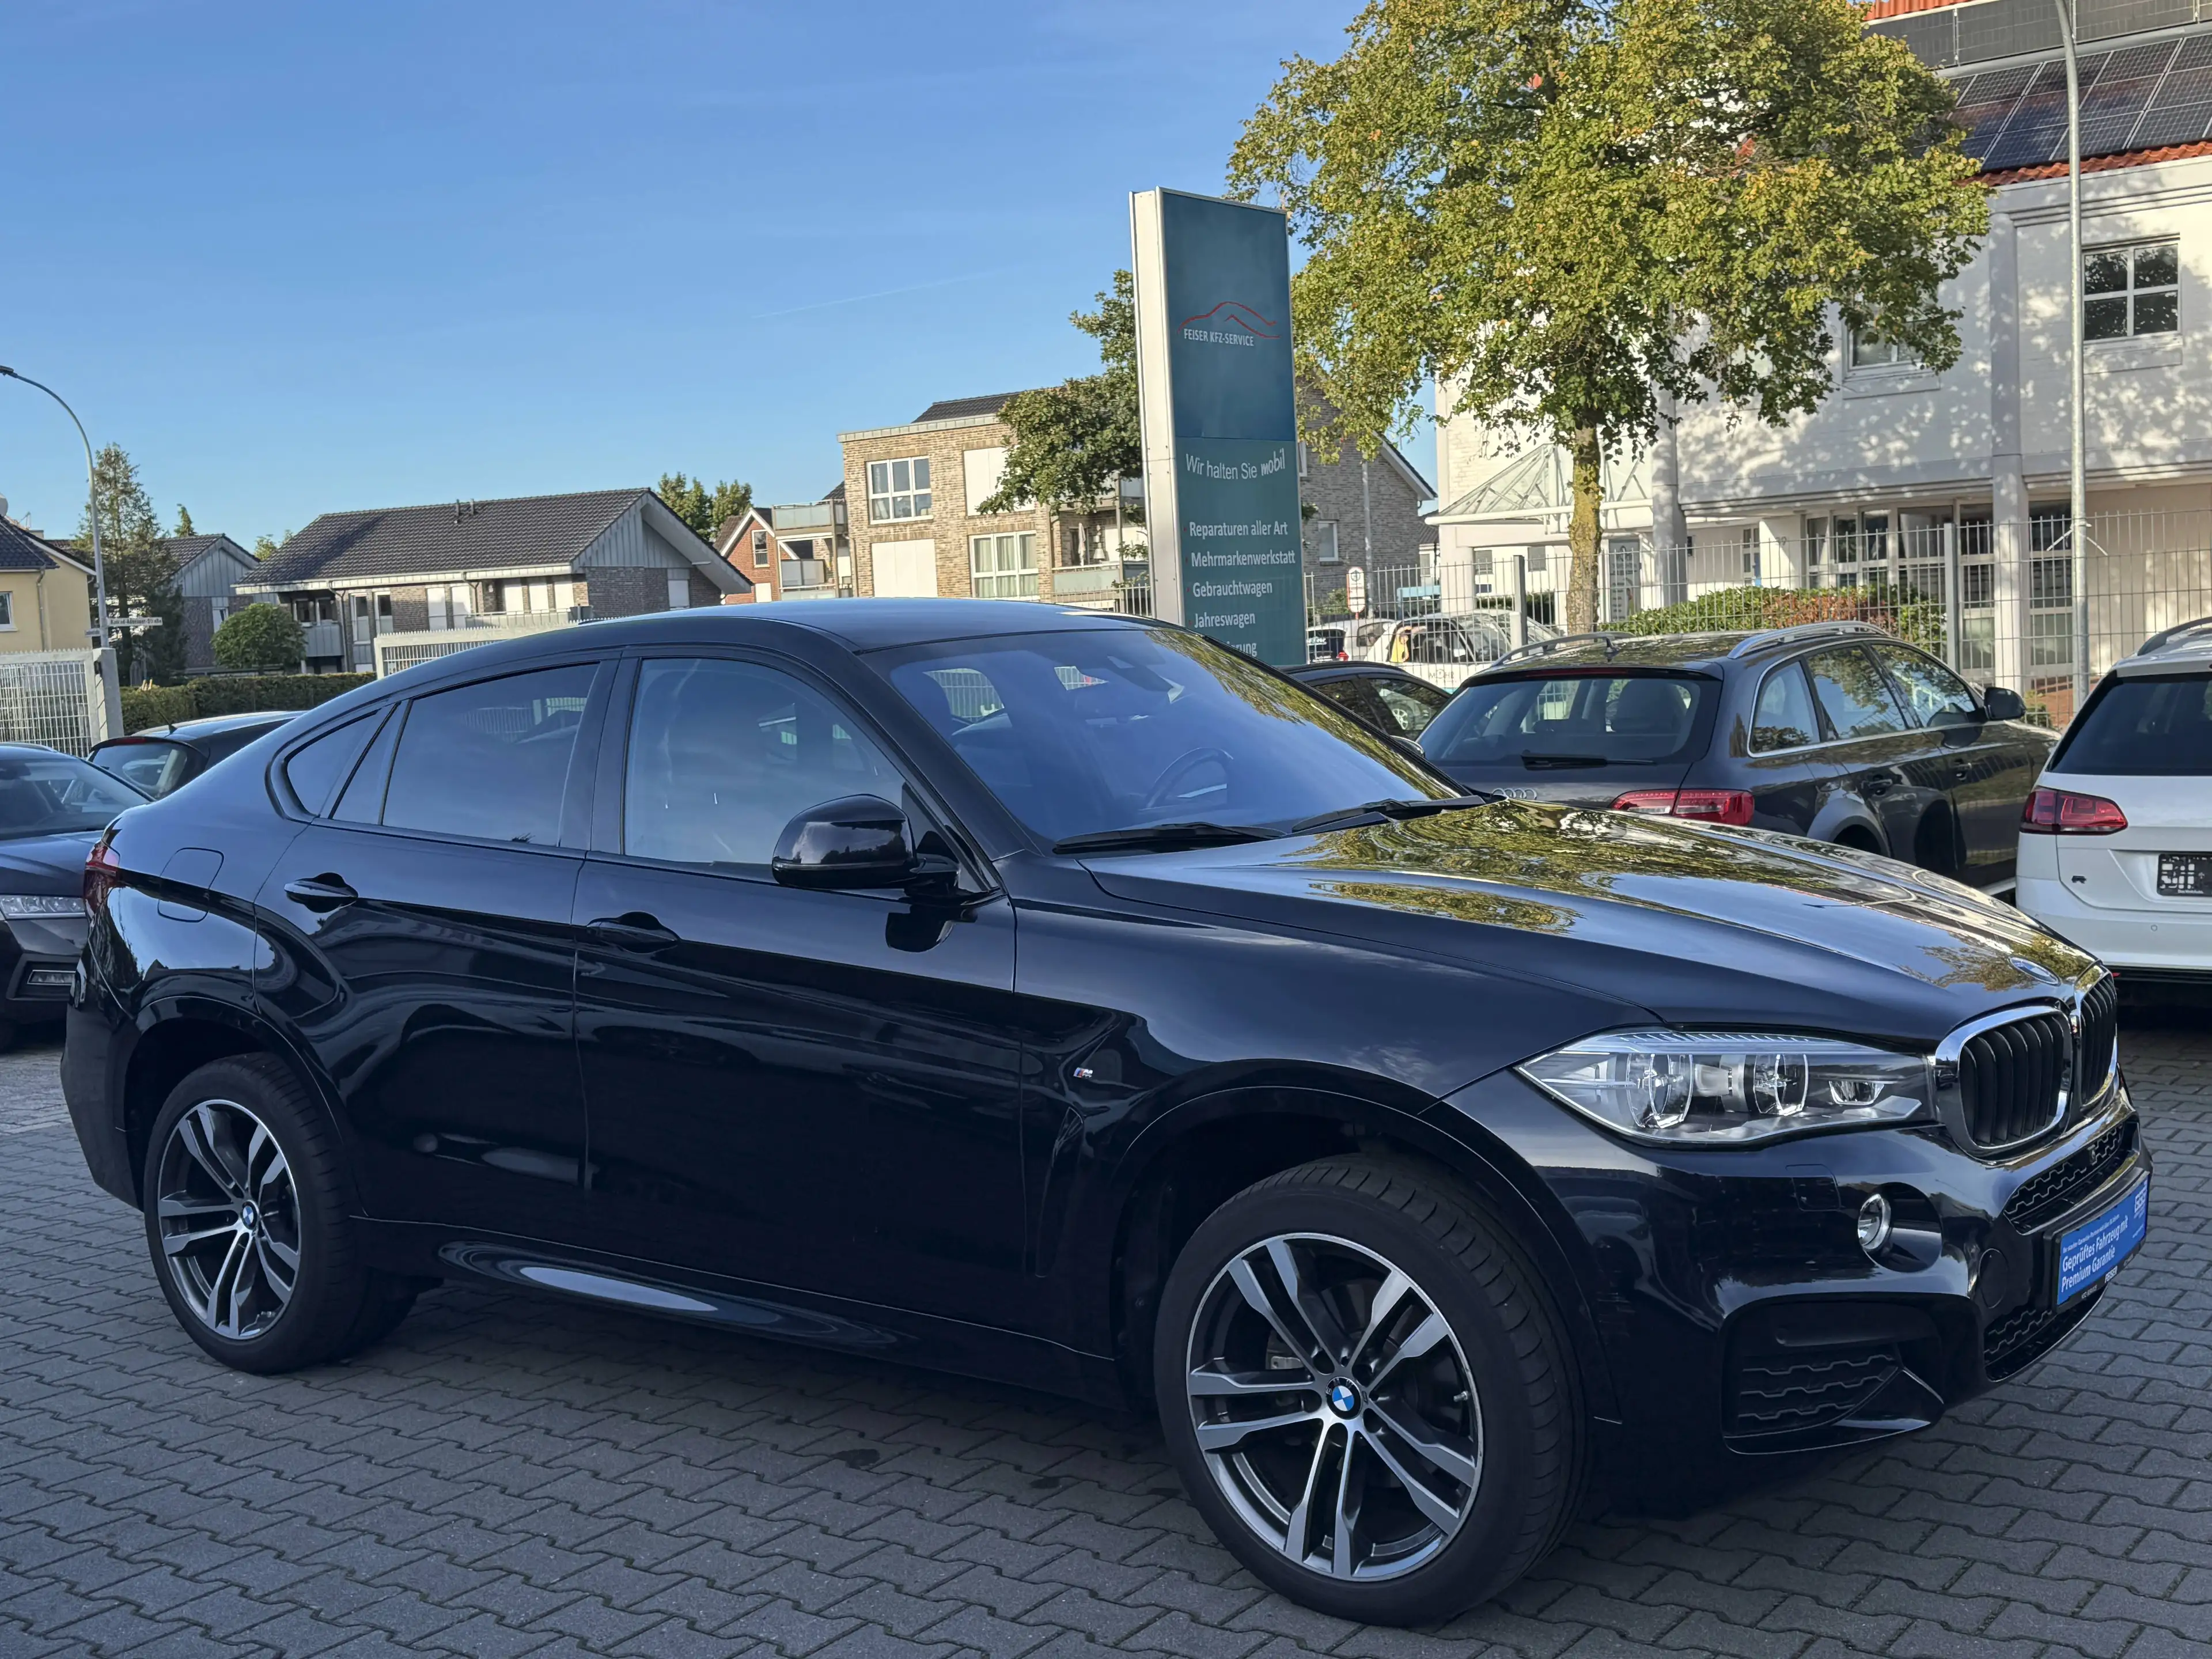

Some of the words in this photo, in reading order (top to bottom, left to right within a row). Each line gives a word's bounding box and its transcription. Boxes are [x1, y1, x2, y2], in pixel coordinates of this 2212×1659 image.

[1184, 328, 1209, 342] FEISER
[1210, 332, 1254, 346] KFZ-SERVICE
[1185, 453, 1205, 475] Wir
[1207, 460, 1238, 479] halten
[1241, 462, 1257, 479] Sie
[1260, 448, 1285, 476] mobil
[1190, 521, 1249, 540] Reparaturen
[1251, 520, 1271, 536] aller
[1274, 521, 1288, 536] Art
[1191, 549, 1296, 567] Mehrmarkenwerkstatt
[1192, 580, 1272, 597] Gebrauchtwagen
[1194, 612, 1256, 628] Jahreswagen
[2063, 1243, 2095, 1272] Geprüftes
[2096, 1225, 2120, 1253] Fahrzeug
[2061, 1264, 2091, 1293] Premium
[2092, 1245, 2115, 1272] Garantie
